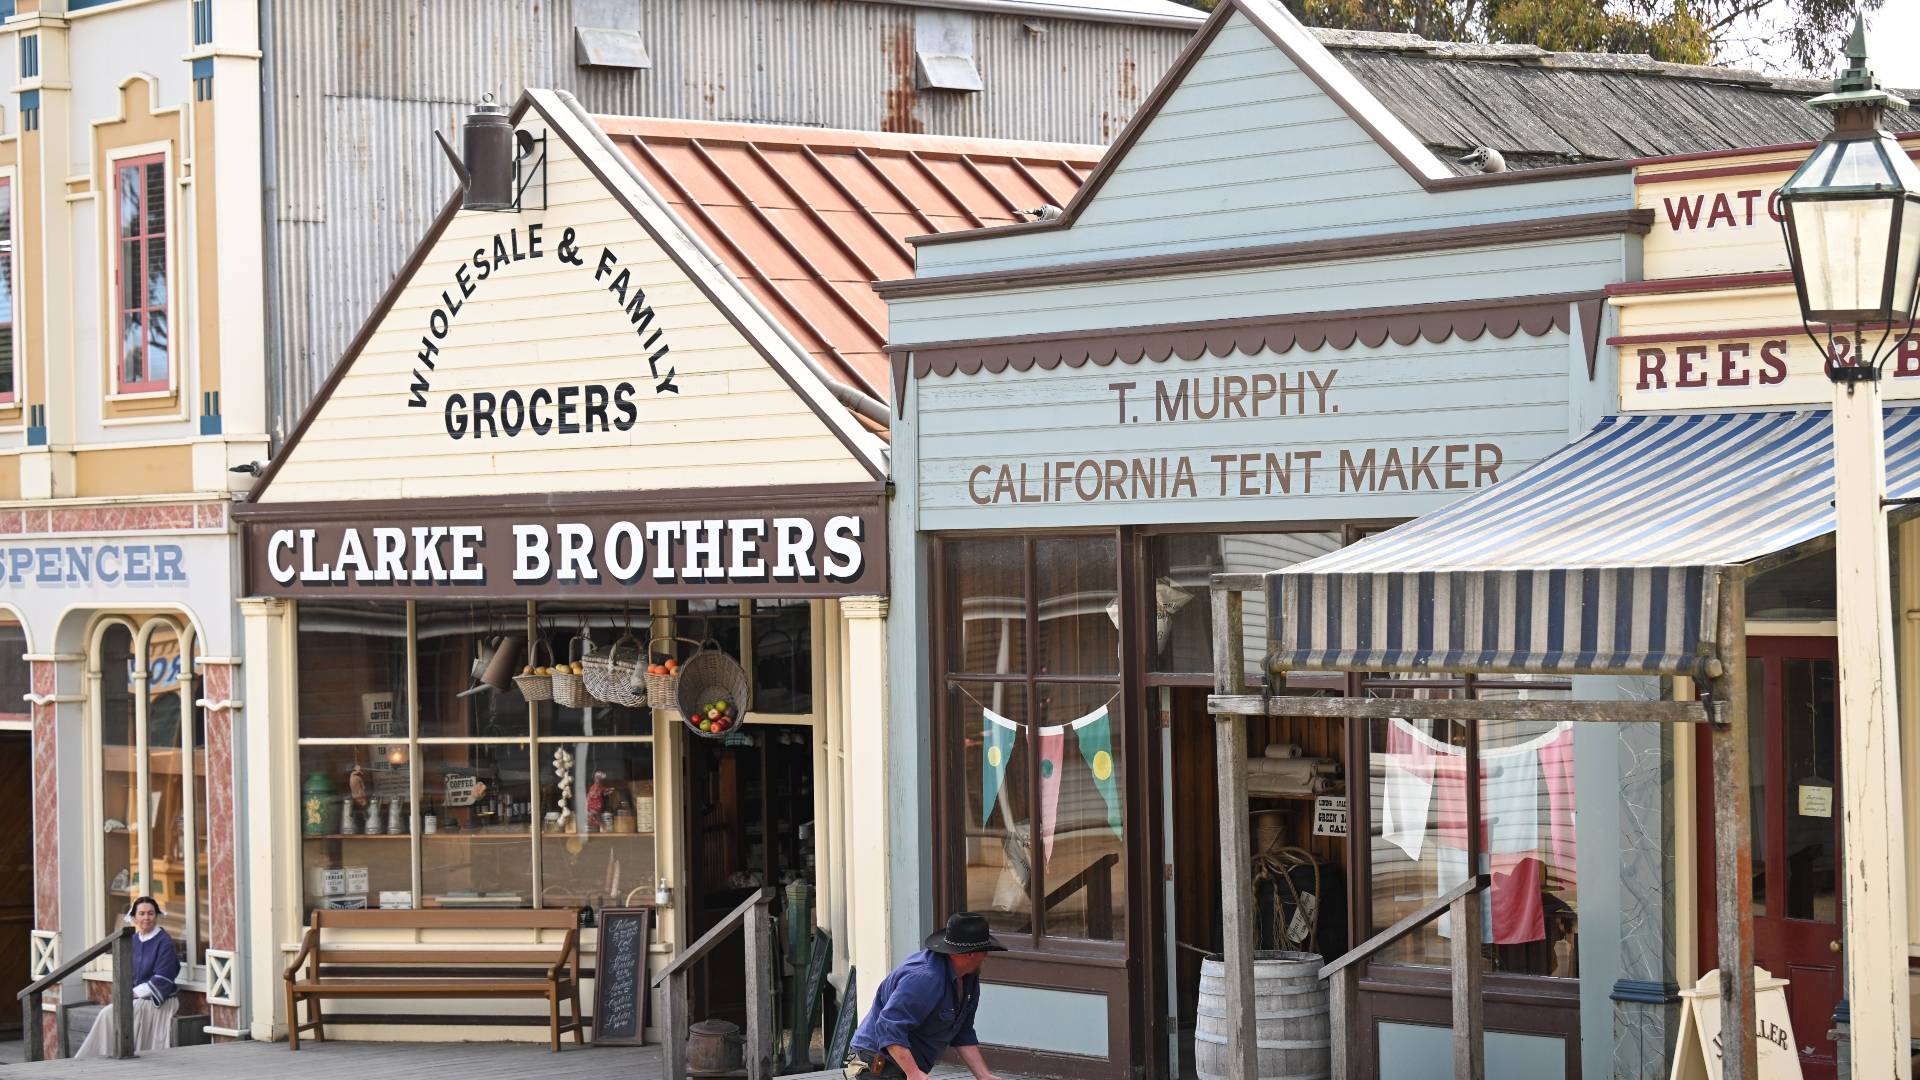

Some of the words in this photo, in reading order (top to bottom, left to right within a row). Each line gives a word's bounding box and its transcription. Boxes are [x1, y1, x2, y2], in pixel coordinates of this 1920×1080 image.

[408, 223, 544, 408] WHOLESALE
[557, 226, 584, 266] &
[595, 247, 679, 394] FAMILY
[1636, 340, 1788, 390] REES
[445, 382, 638, 440] GROCERS
[1108, 382, 1138, 424] T.
[1155, 369, 1339, 421] MURPHY.
[968, 456, 1198, 505] CALIFORNIA
[1210, 450, 1322, 496] TENT
[1339, 444, 1503, 493] MAKER
[0, 544, 187, 584] PENCER
[267, 525, 485, 584] CLARKE
[512, 516, 863, 581] BROTHERS
[450, 780, 473, 789] COFFEE
[1318, 812, 1337, 823] GREEN
